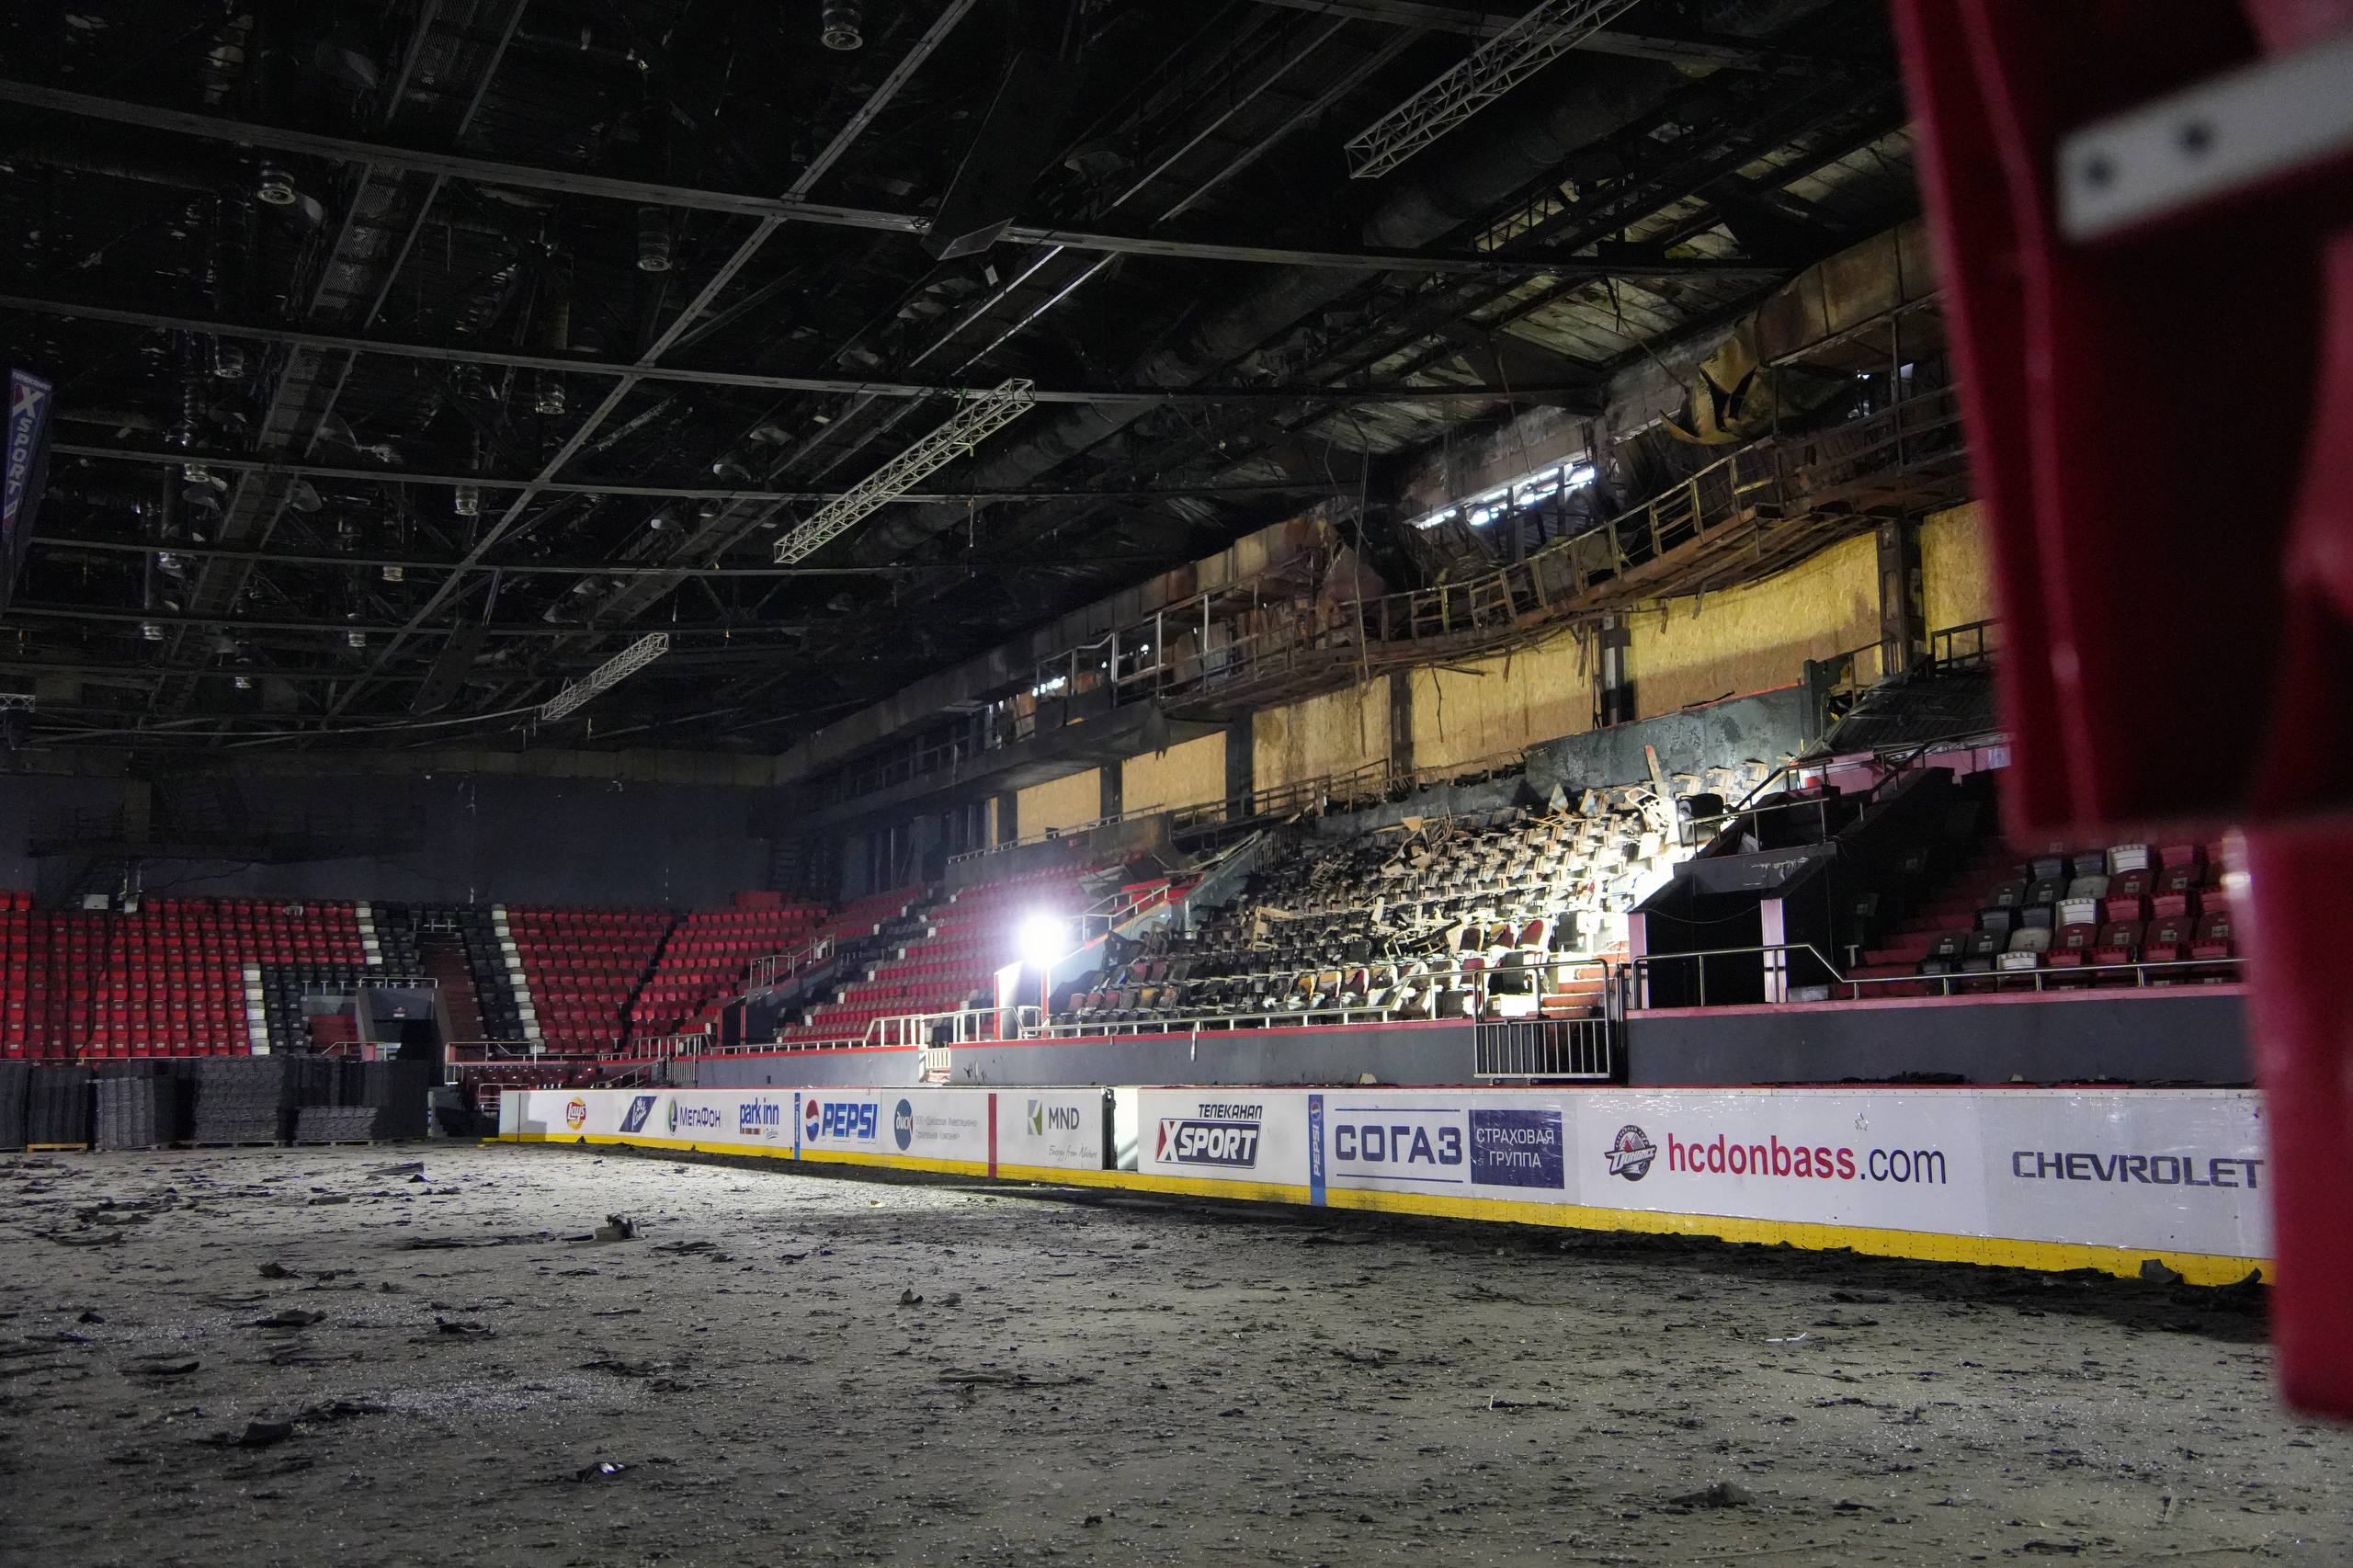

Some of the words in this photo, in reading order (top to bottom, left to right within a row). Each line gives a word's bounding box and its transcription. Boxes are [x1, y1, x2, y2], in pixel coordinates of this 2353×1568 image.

[740, 1097, 761, 1134] park
[763, 1097, 779, 1125] inn
[822, 1103, 878, 1142] PEPSI
[1049, 1107, 1080, 1130] MND
[1199, 1104, 1263, 1119] ТЕЛЕКАНАЛ
[1313, 1124, 1322, 1176] PEPSI
[1336, 1124, 1463, 1165] СОГАЗ
[1476, 1128, 1555, 1146] СТРАХОВАЯ
[1489, 1150, 1542, 1168] ГРУППА
[1667, 1132, 1947, 1185] hcdonbass.com
[2012, 1150, 2266, 1189] CHEVROLET
